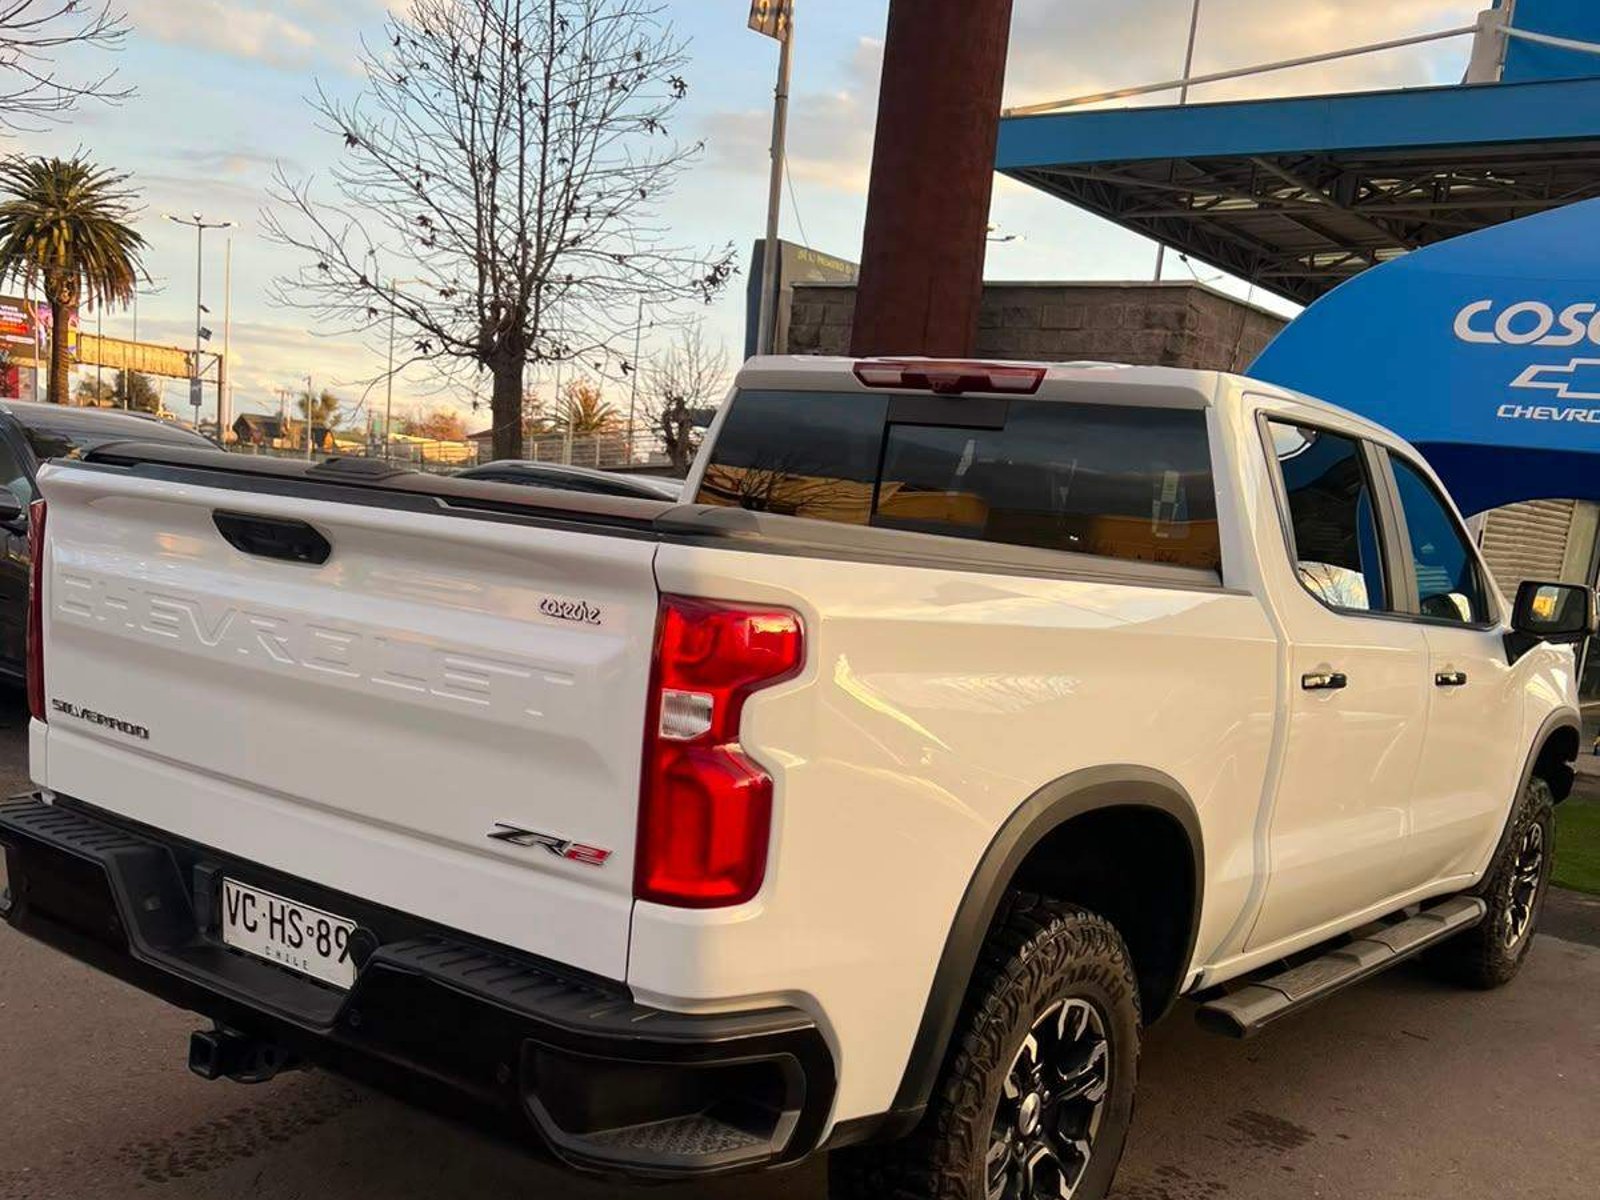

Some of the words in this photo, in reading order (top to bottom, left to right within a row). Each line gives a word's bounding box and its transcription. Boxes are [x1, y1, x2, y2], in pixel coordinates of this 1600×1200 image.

[1453, 299, 1600, 346] COS
[51, 698, 150, 740] SILVERADO
[486, 822, 614, 867] ZR2
